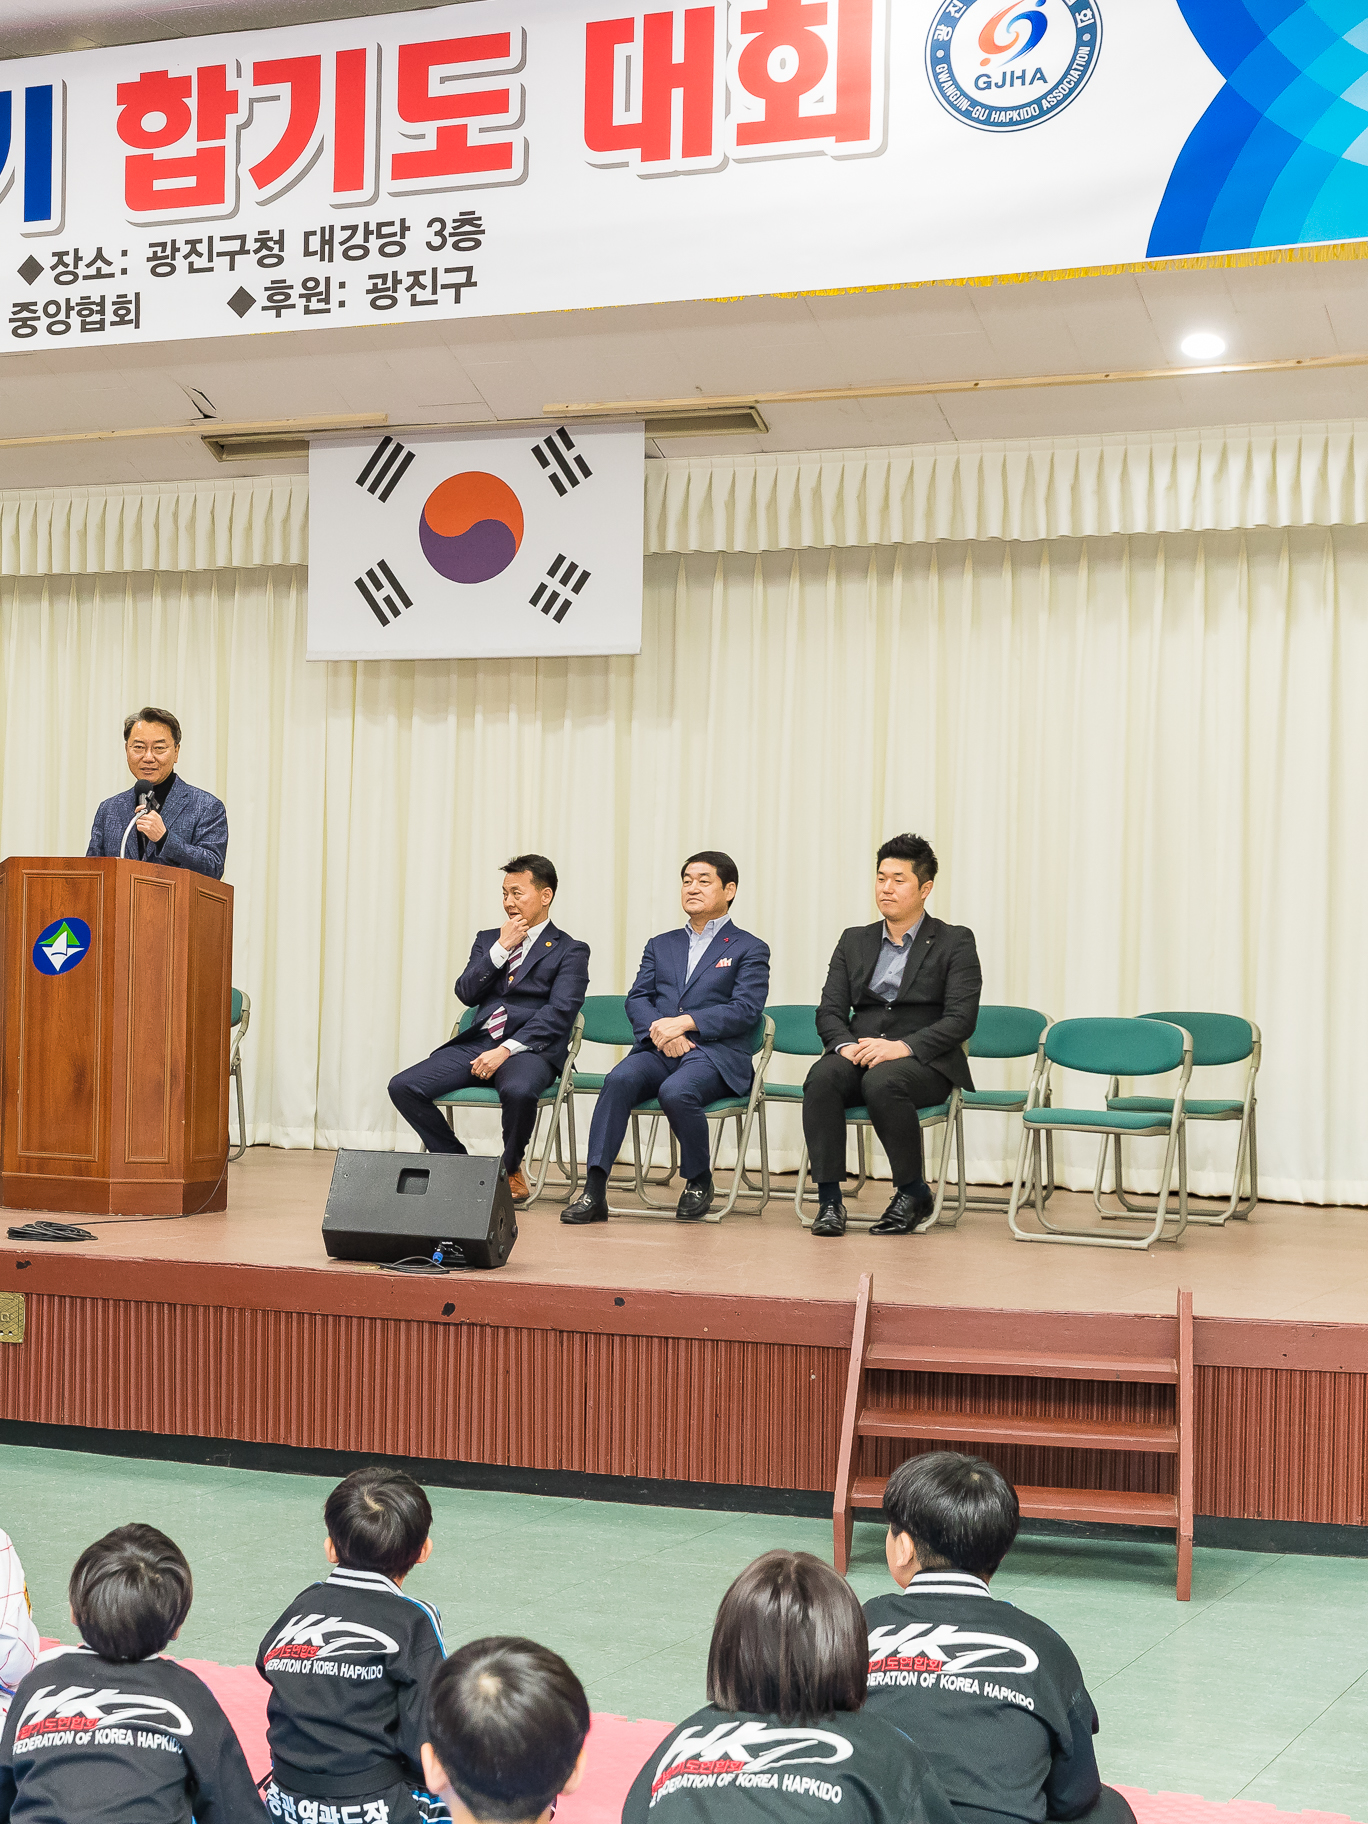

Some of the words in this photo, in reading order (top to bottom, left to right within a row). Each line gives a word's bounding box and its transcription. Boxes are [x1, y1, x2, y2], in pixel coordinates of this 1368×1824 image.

[935, 63, 989, 121] GWANGJIN-GU
[990, 103, 1040, 123] HAPKIDO
[1042, 46, 1091, 111] ASSOCIATION
[974, 67, 1048, 91] GJHA
[116, 32, 513, 212] 합기도
[584, 0, 873, 162] 대회
[50, 246, 128, 286] 장소:
[146, 228, 285, 278] 광진구청
[303, 217, 411, 263] 대강당
[425, 210, 486, 252] 3층
[261, 276, 347, 318] 후원:
[365, 265, 478, 311] 광진구
[8, 291, 141, 338] 중앙협회
[302, 1660, 312, 1674] OF
[312, 1661, 339, 1676] KOREA
[340, 1662, 384, 1680] HAPKIDO
[866, 1671, 918, 1688] ERATION
[920, 1672, 938, 1689] OF
[940, 1674, 980, 1695] KOREA
[983, 1682, 1035, 1711] HAPKIDO
[75, 1731, 93, 1746] OF
[94, 1729, 135, 1746] KOREA
[717, 1772, 735, 1787] OF
[735, 1773, 779, 1789] KOREA
[782, 1773, 843, 1804] HAPKIDO
